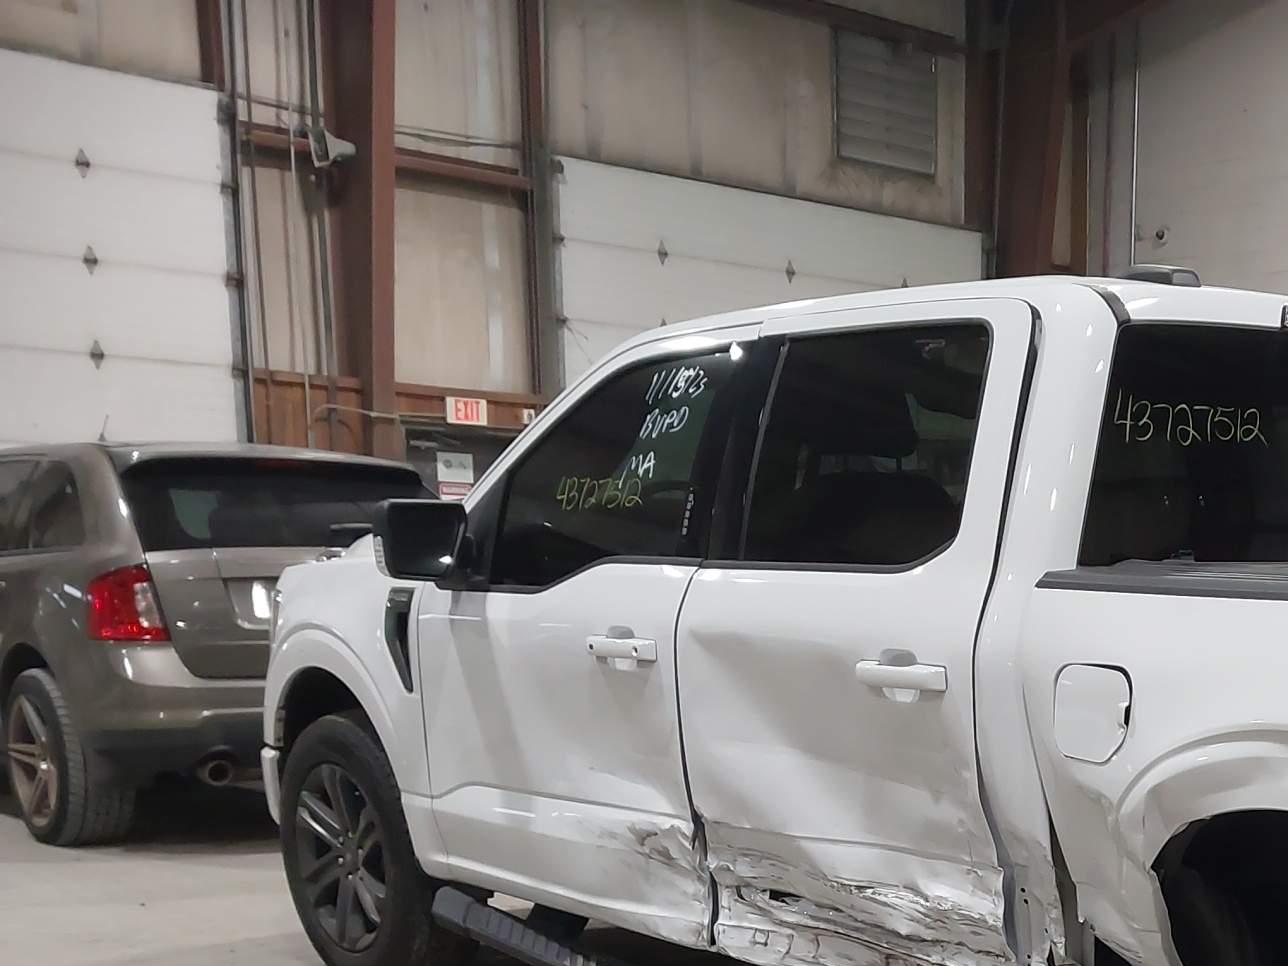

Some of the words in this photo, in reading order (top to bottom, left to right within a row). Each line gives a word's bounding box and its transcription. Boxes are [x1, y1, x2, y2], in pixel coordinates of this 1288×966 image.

[454, 398, 481, 422] EXIT
[1113, 387, 1270, 449] 43727512
[556, 475, 643, 512] 43727512
